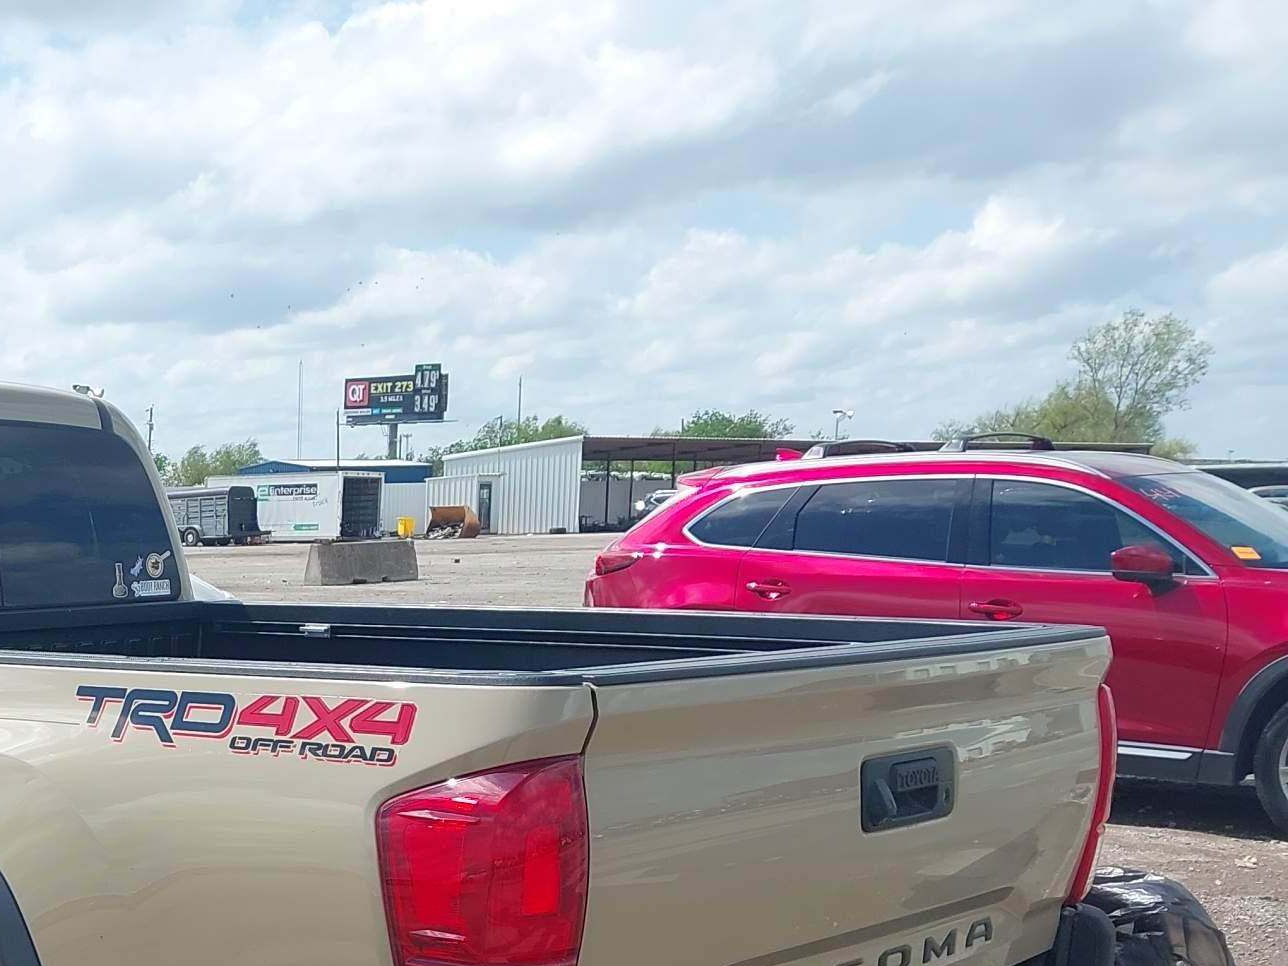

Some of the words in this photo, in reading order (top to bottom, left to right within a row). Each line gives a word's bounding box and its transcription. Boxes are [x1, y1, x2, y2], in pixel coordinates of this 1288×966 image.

[349, 384, 366, 402] QT
[370, 382, 393, 393] EXIT
[394, 381, 414, 392] 273
[269, 485, 317, 497] Enterprise
[76, 686, 238, 748] TRD
[229, 735, 296, 757] OFF
[297, 740, 398, 767] ROAD
